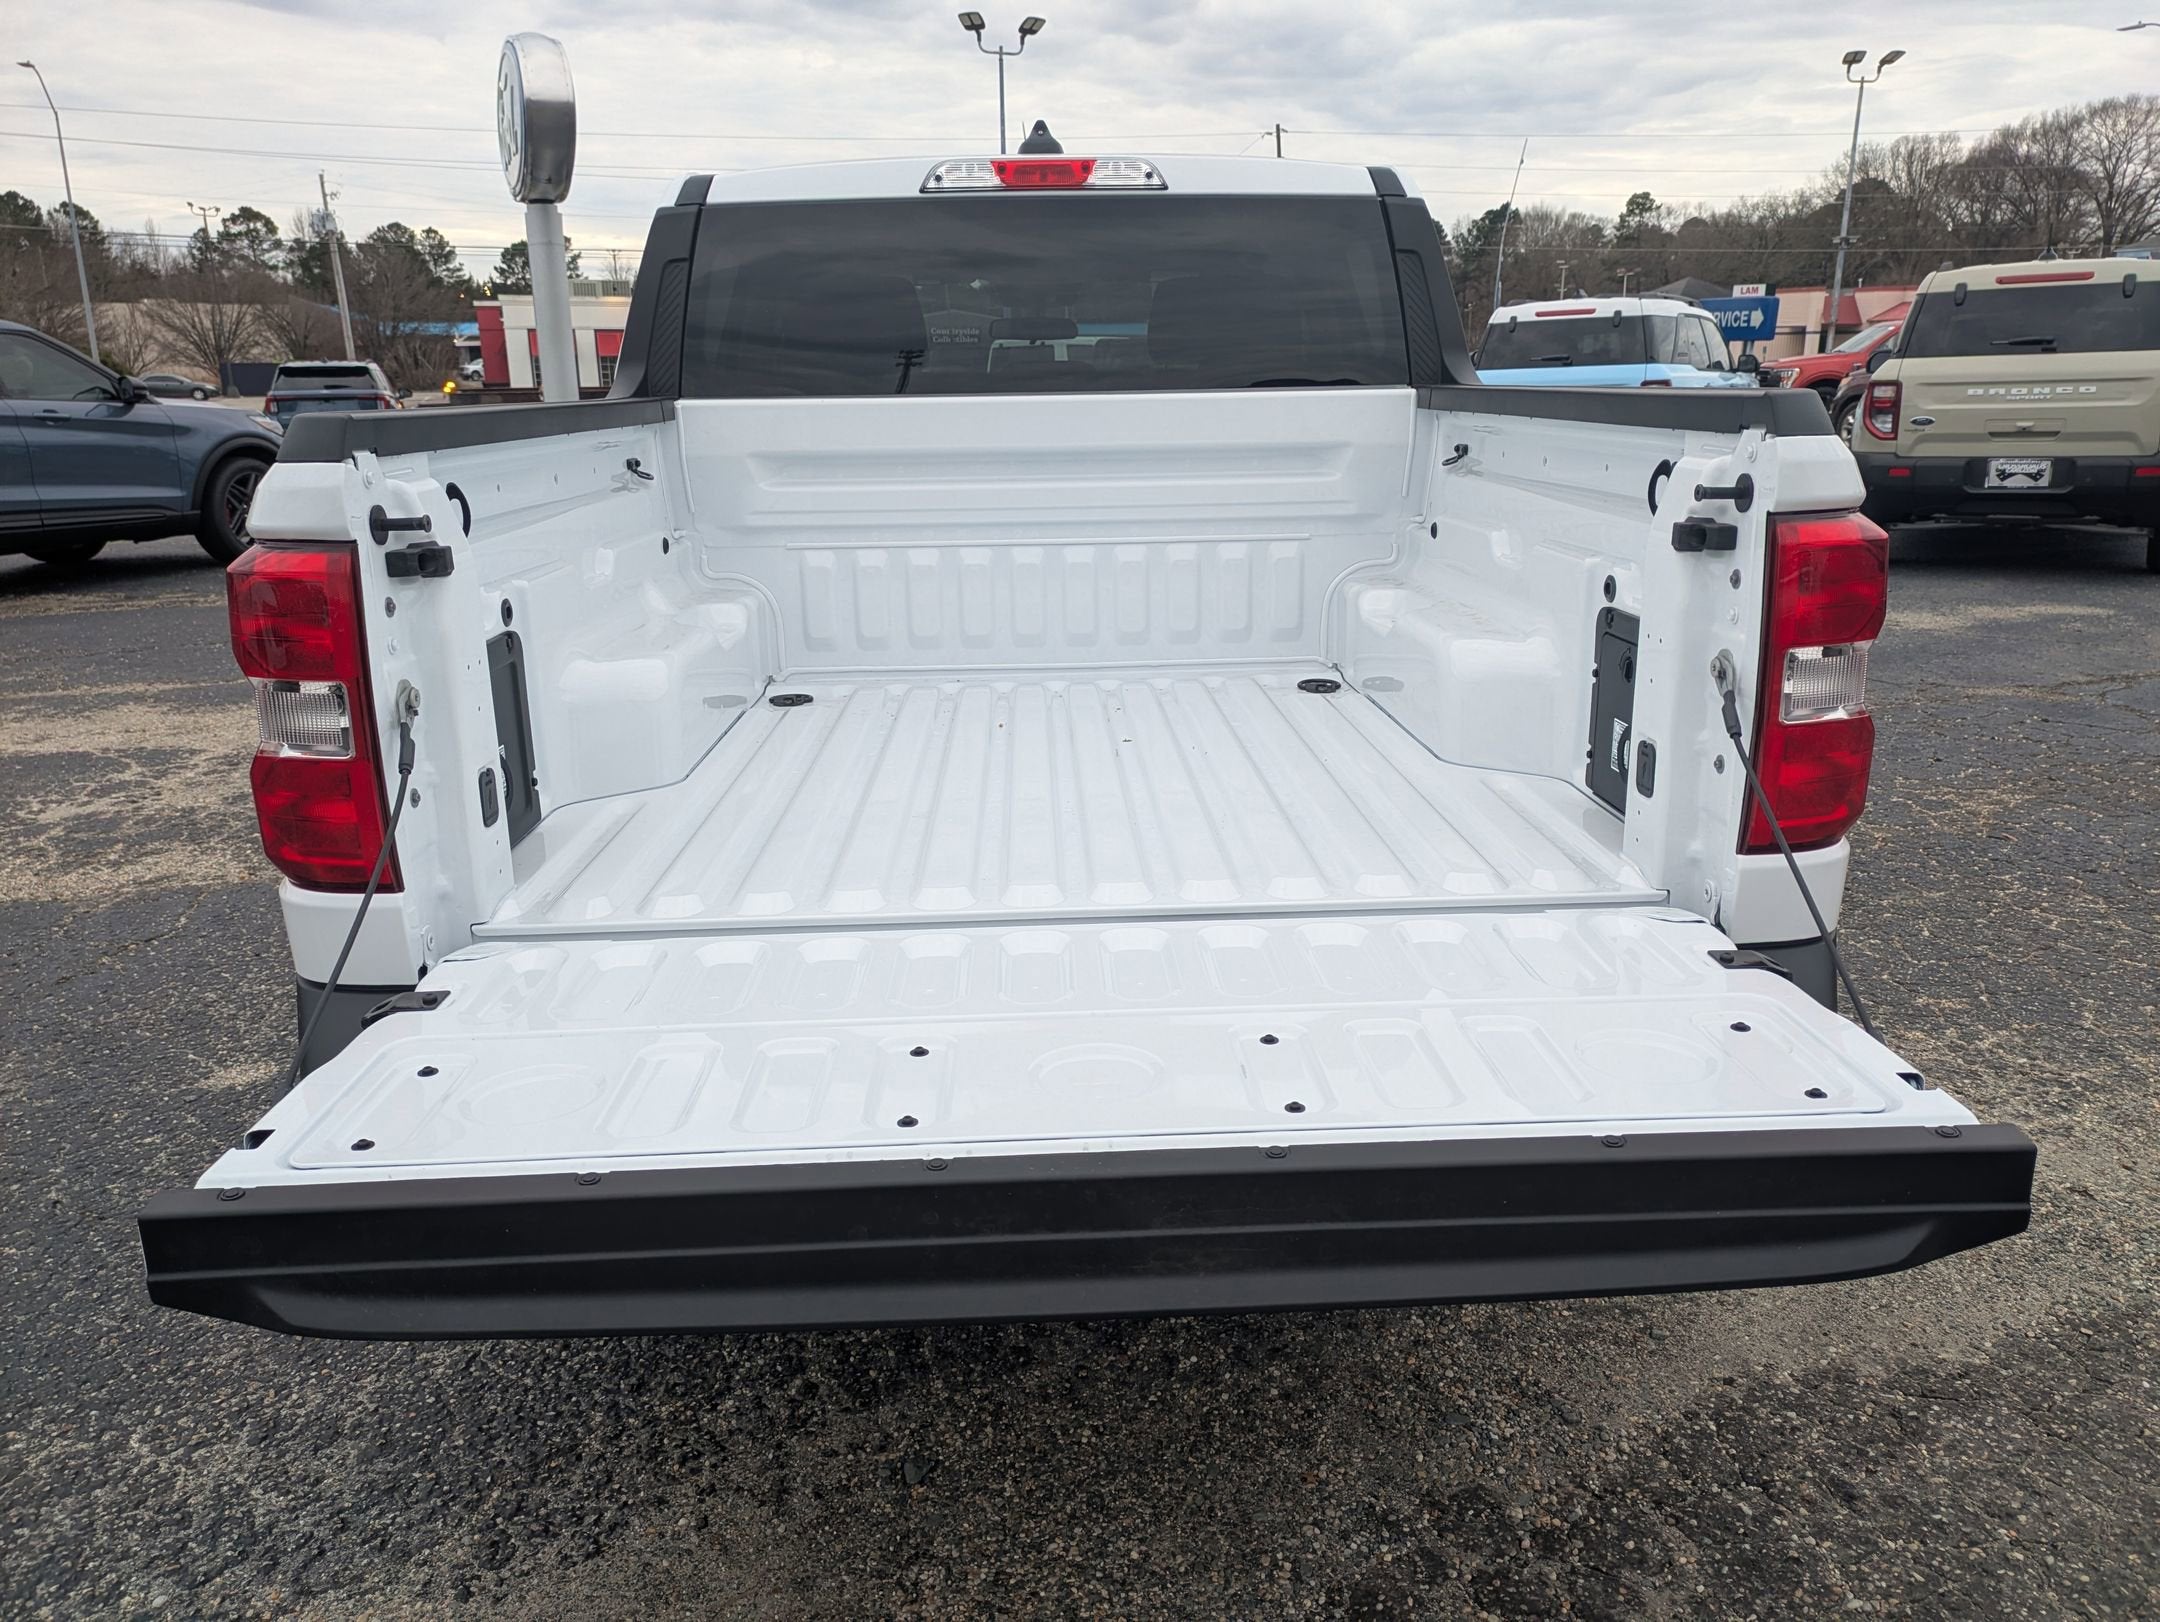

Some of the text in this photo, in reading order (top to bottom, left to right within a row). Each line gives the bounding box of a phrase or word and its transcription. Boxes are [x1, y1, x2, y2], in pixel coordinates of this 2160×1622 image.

[1740, 286, 1759, 295] LAM
[1713, 310, 1749, 327] RVICE
[1967, 386, 2097, 396] BRONCO
